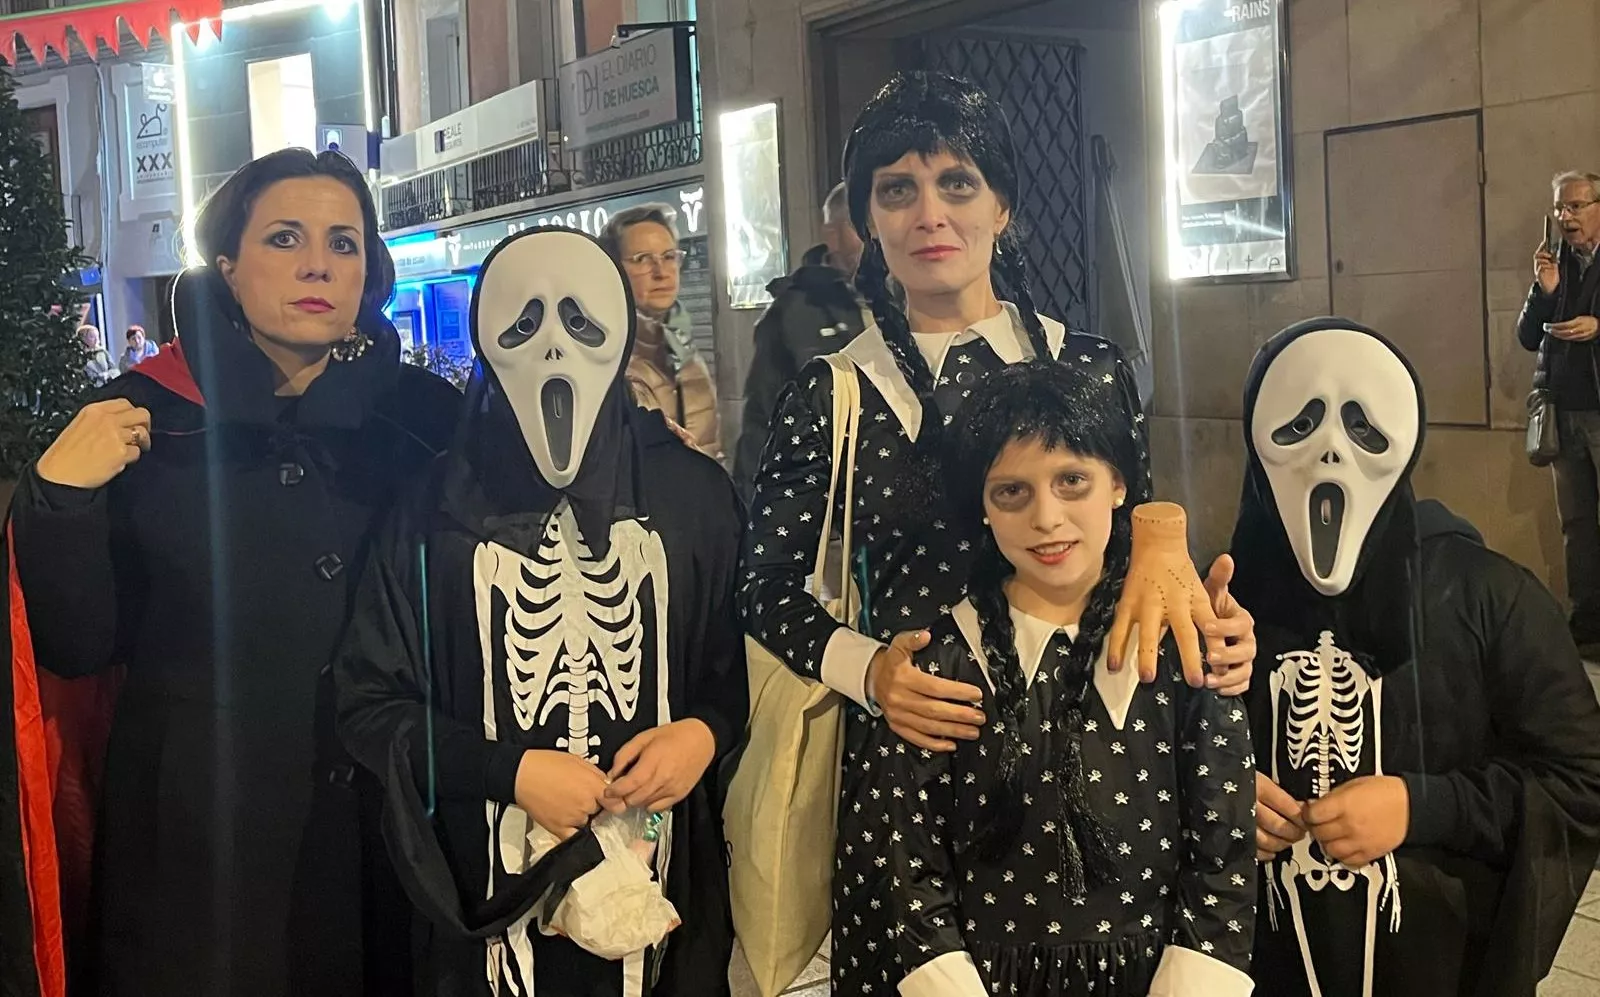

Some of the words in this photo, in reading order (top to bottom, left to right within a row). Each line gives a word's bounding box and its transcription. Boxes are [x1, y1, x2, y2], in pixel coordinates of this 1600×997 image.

[601, 60, 614, 81] EL
[617, 43, 656, 75] DIARIO
[603, 88, 616, 108] DE
[617, 75, 659, 104] HUESCA
[136, 152, 173, 173] XXX
